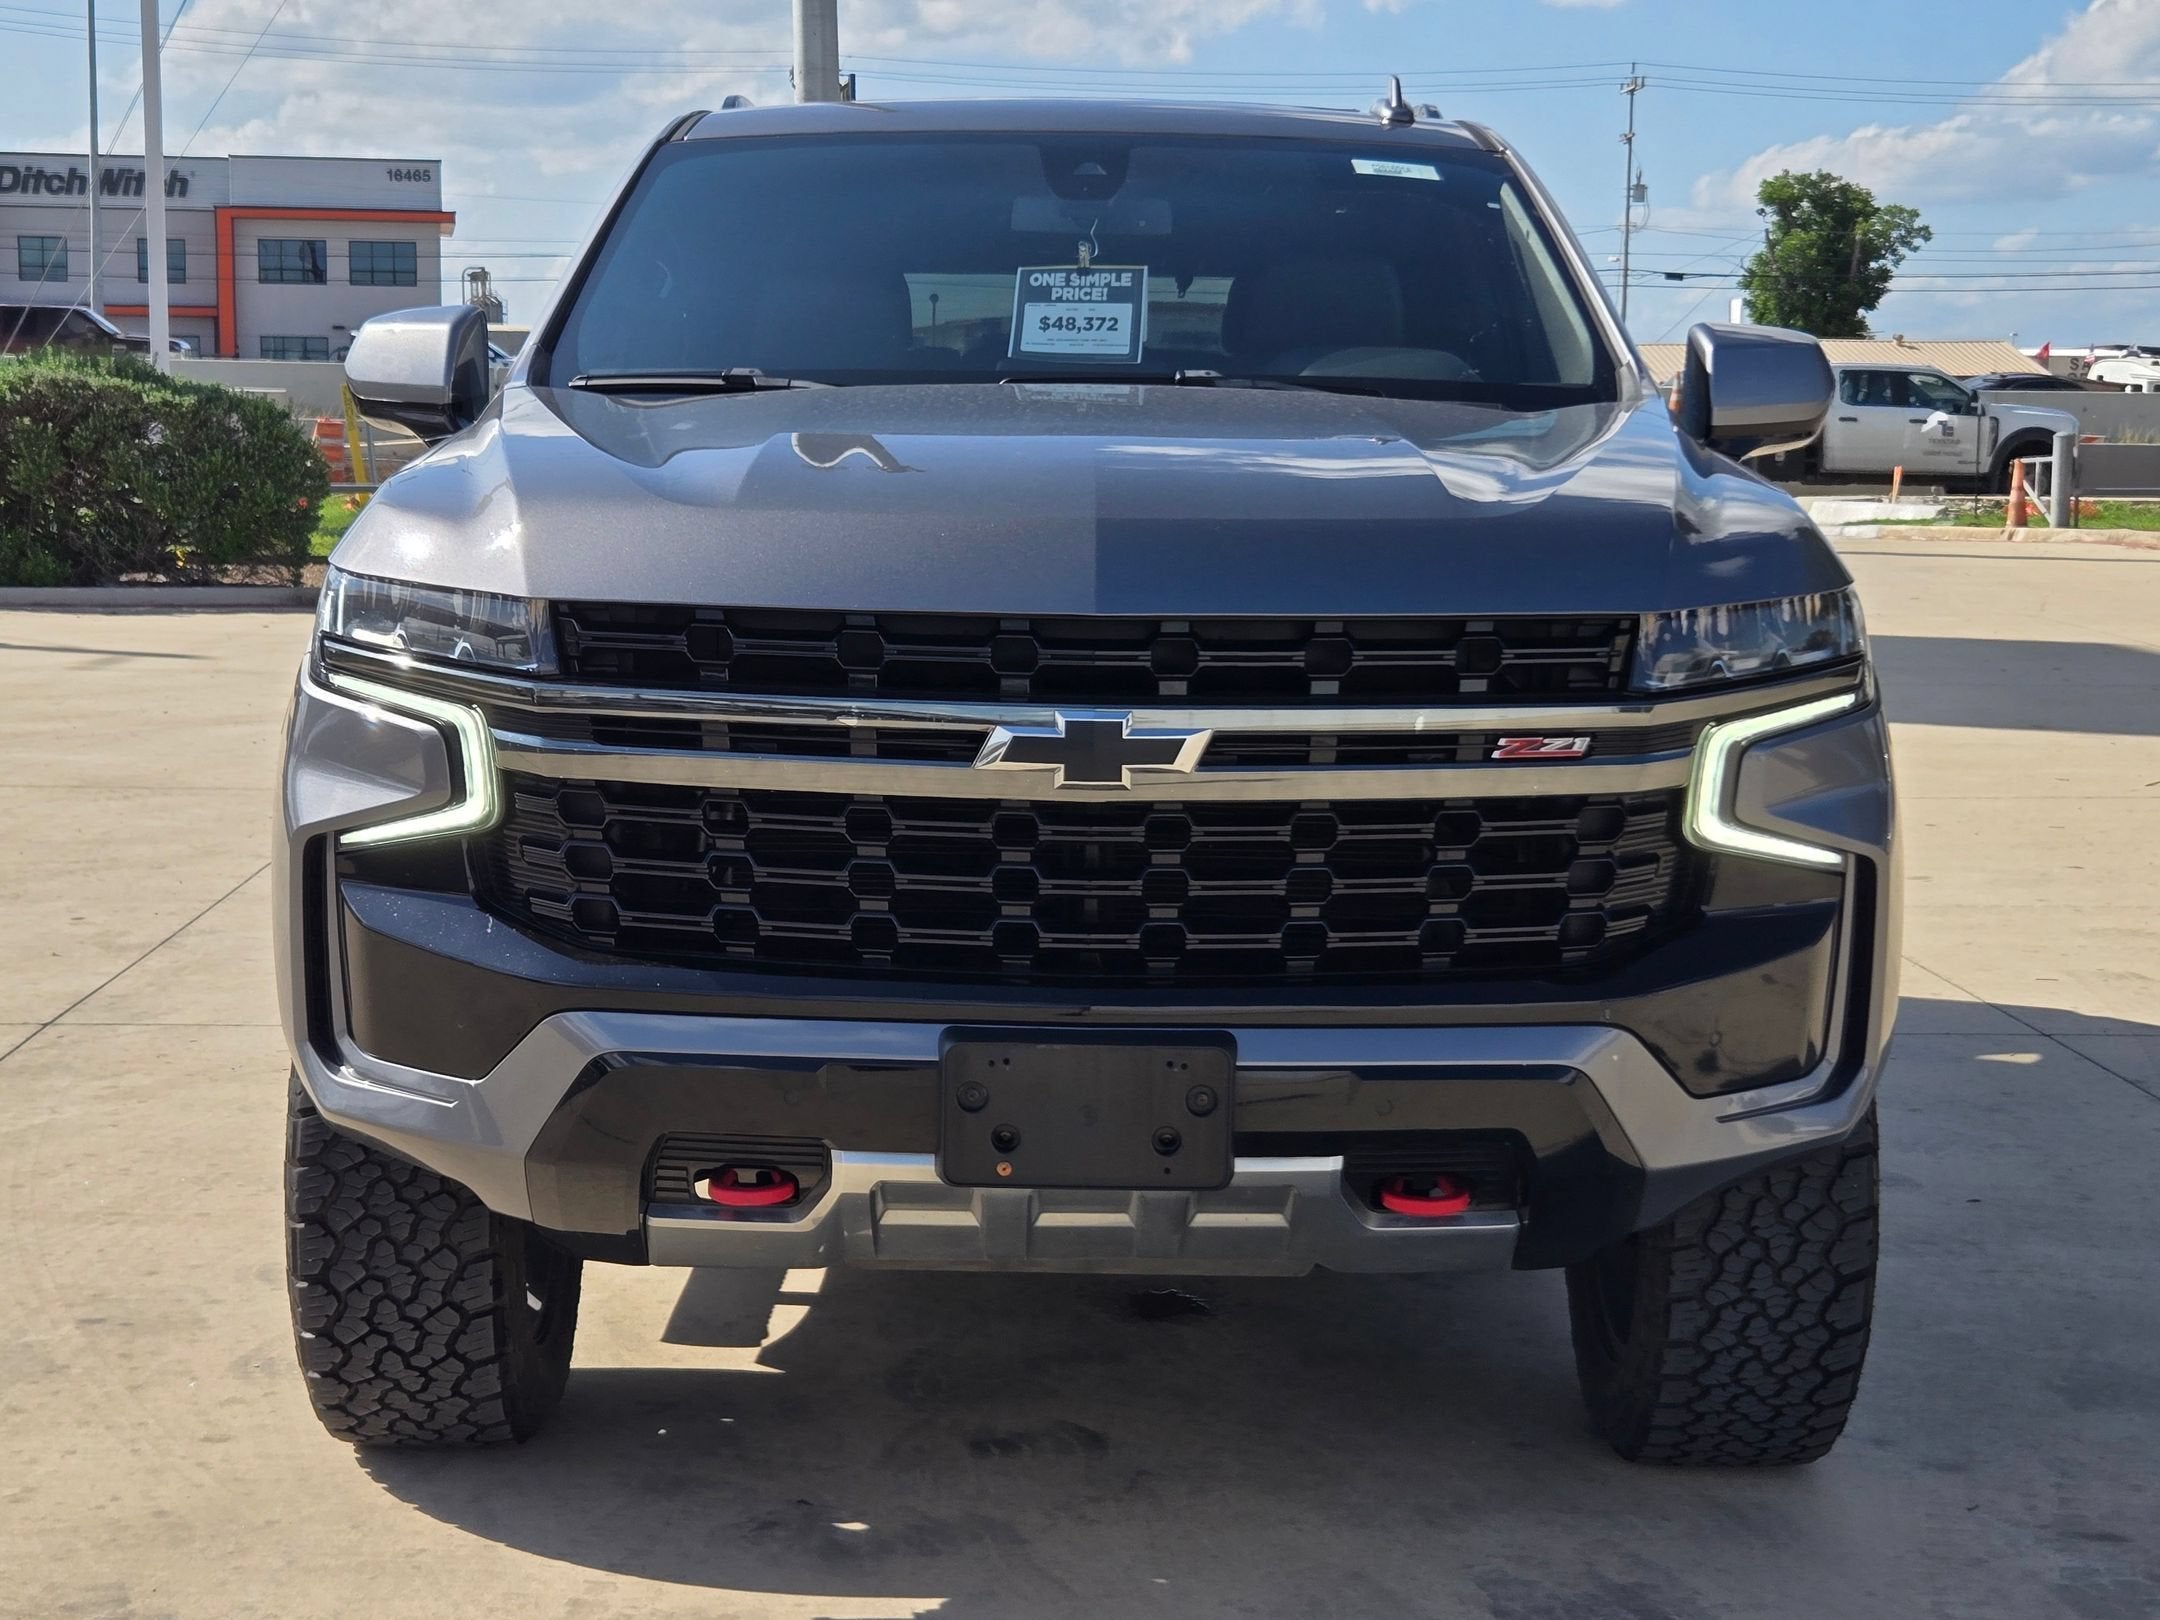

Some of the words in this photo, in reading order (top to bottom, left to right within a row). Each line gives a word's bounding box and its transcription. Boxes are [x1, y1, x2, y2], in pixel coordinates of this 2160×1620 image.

[0, 165, 88, 196] Ditch
[100, 168, 189, 199] With
[386, 168, 432, 183] 16465
[1029, 272, 1066, 287] ONE
[1069, 272, 1132, 287] SIMPLE
[1051, 287, 1108, 301] PRICE!
[1038, 315, 1119, 334] $48,372
[1491, 737, 1591, 758] Z71
